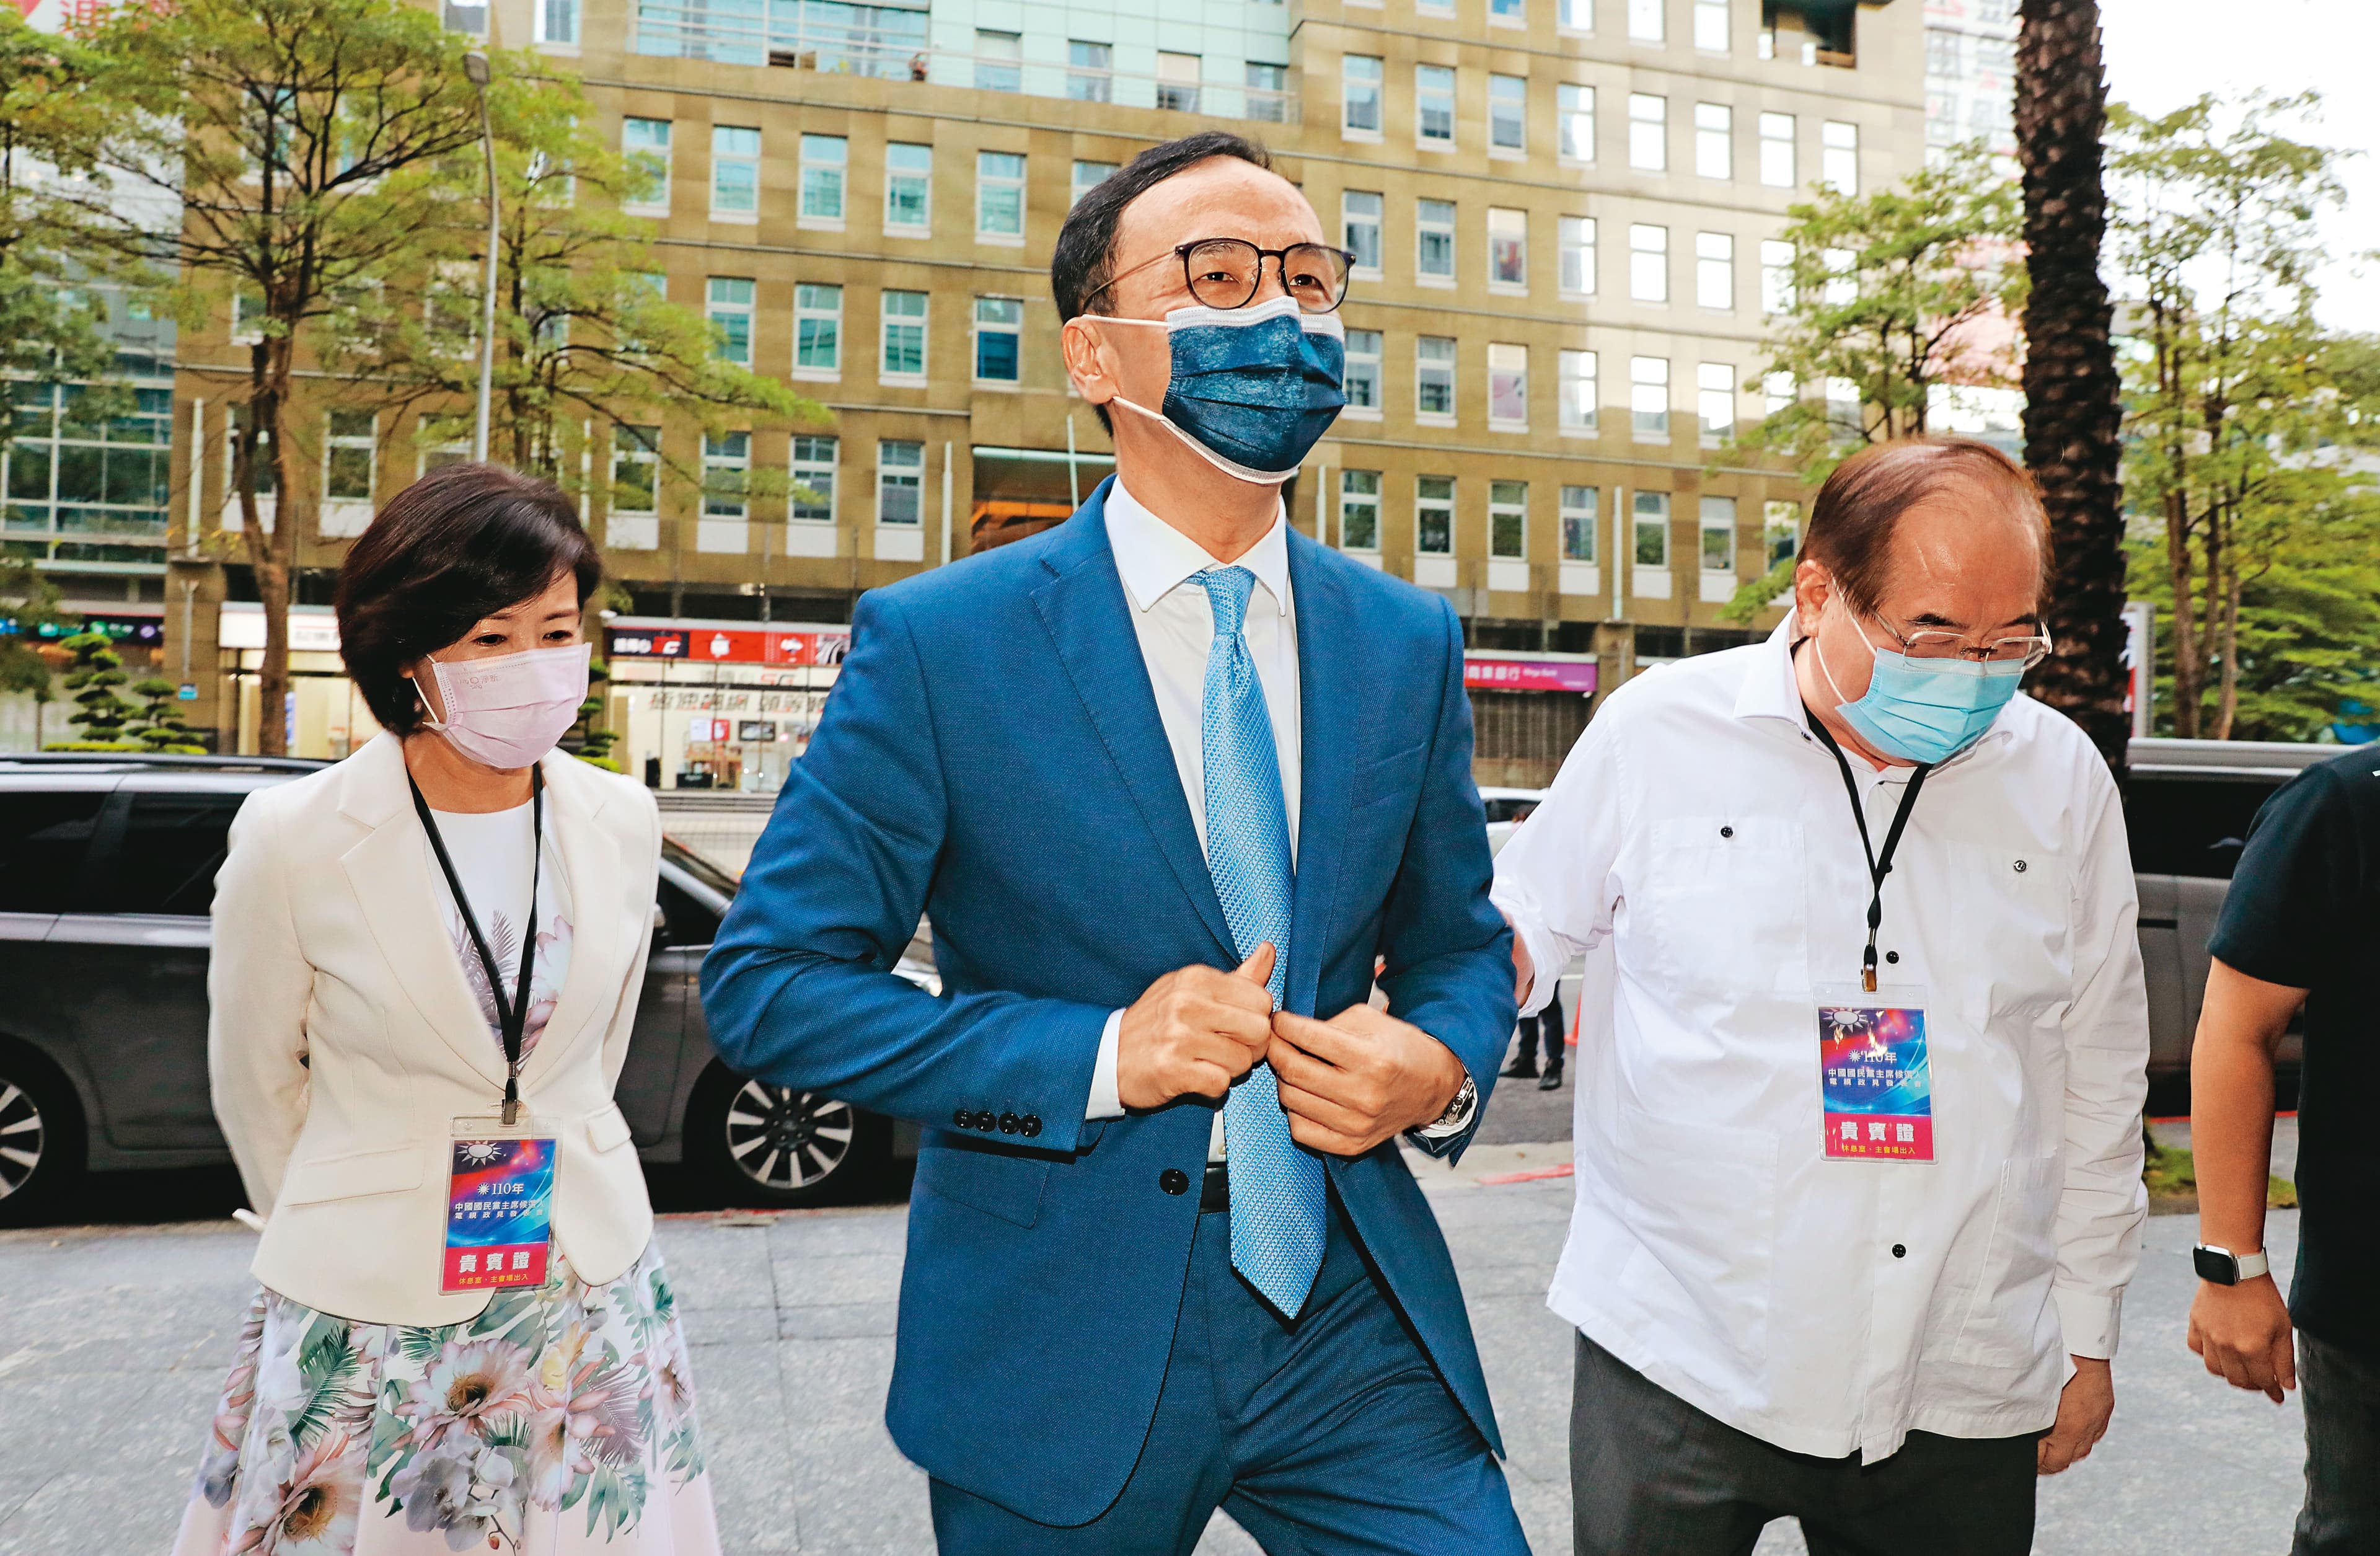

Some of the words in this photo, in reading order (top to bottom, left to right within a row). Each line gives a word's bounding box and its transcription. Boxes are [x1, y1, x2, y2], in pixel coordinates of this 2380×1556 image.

[1840, 1121, 1914, 1142] 貴賓證
[491, 1183, 524, 1195] 110年
[459, 1251, 530, 1273] 貴賓證
